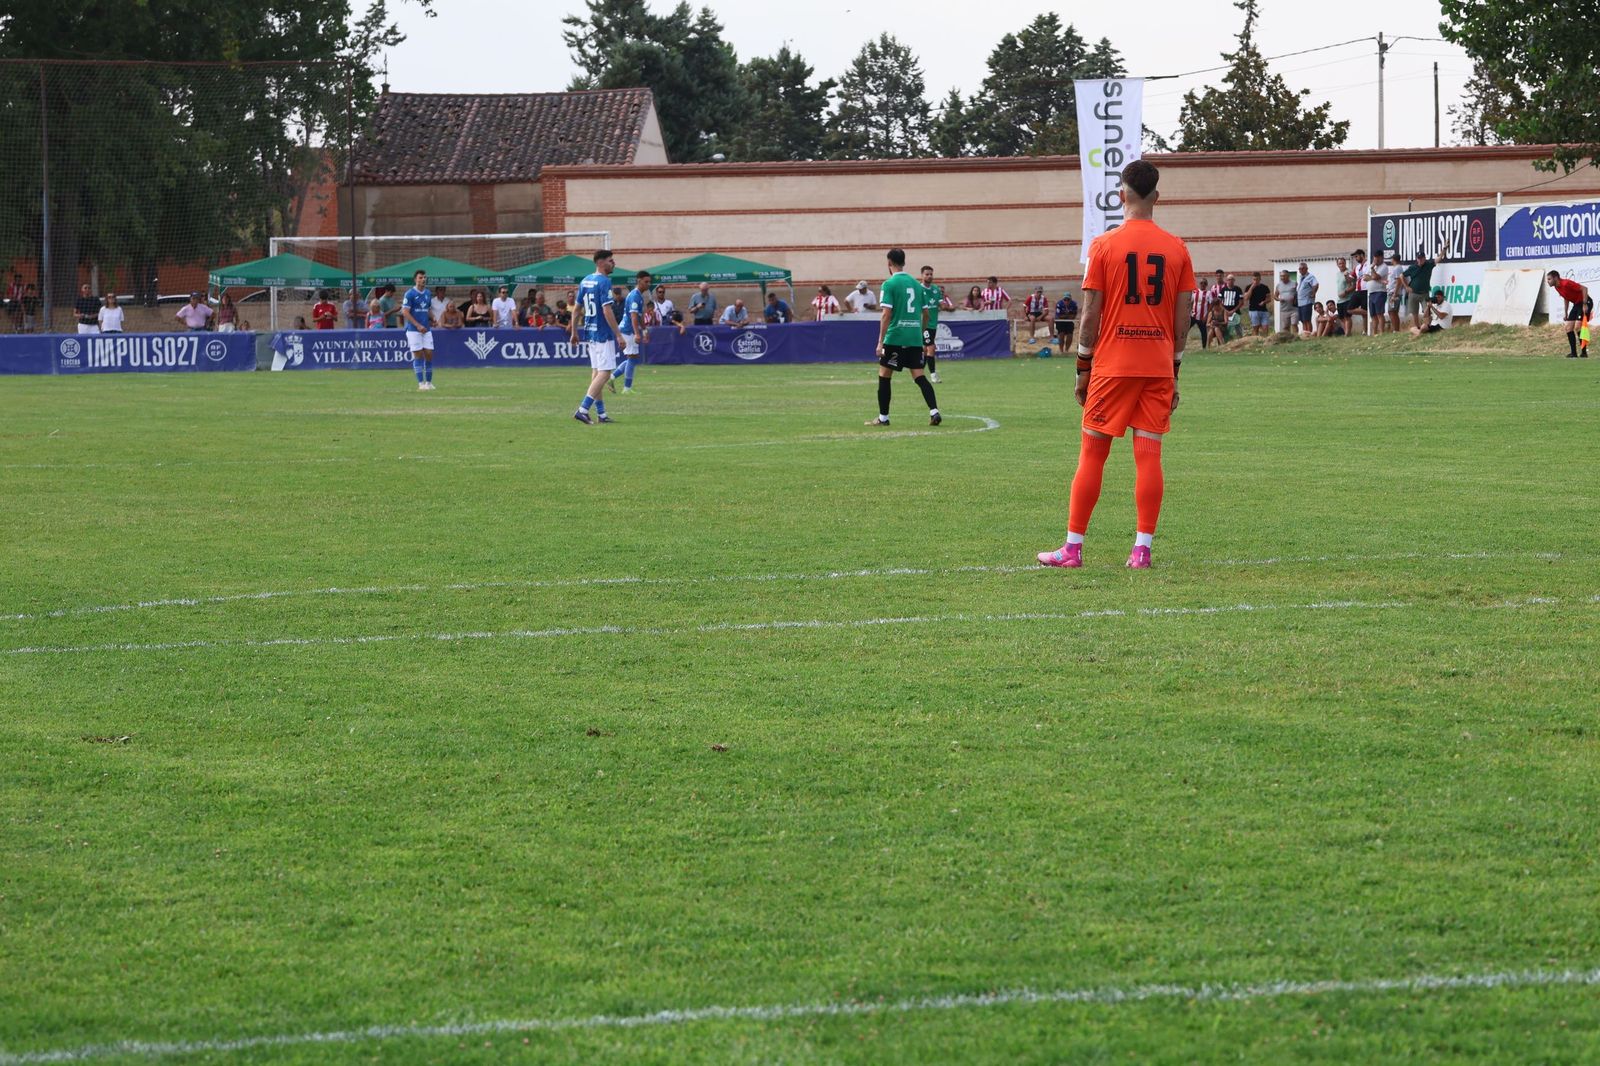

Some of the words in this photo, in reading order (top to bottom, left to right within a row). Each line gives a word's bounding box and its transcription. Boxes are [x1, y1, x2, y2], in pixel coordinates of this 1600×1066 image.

[1399, 215, 1468, 261] IMPULSO27
[1506, 246, 1523, 257] CENTRO
[1525, 244, 1551, 256] COMERCIAL
[1125, 252, 1166, 305] 13
[583, 293, 597, 317] 15
[907, 287, 916, 313] 2
[87, 336, 199, 367] IMPULSO27
[312, 340, 398, 350] AYUNTAMIENTO
[312, 350, 415, 363] VILLARALBO
[501, 342, 550, 360] CAJA
[554, 342, 620, 359] RUR
